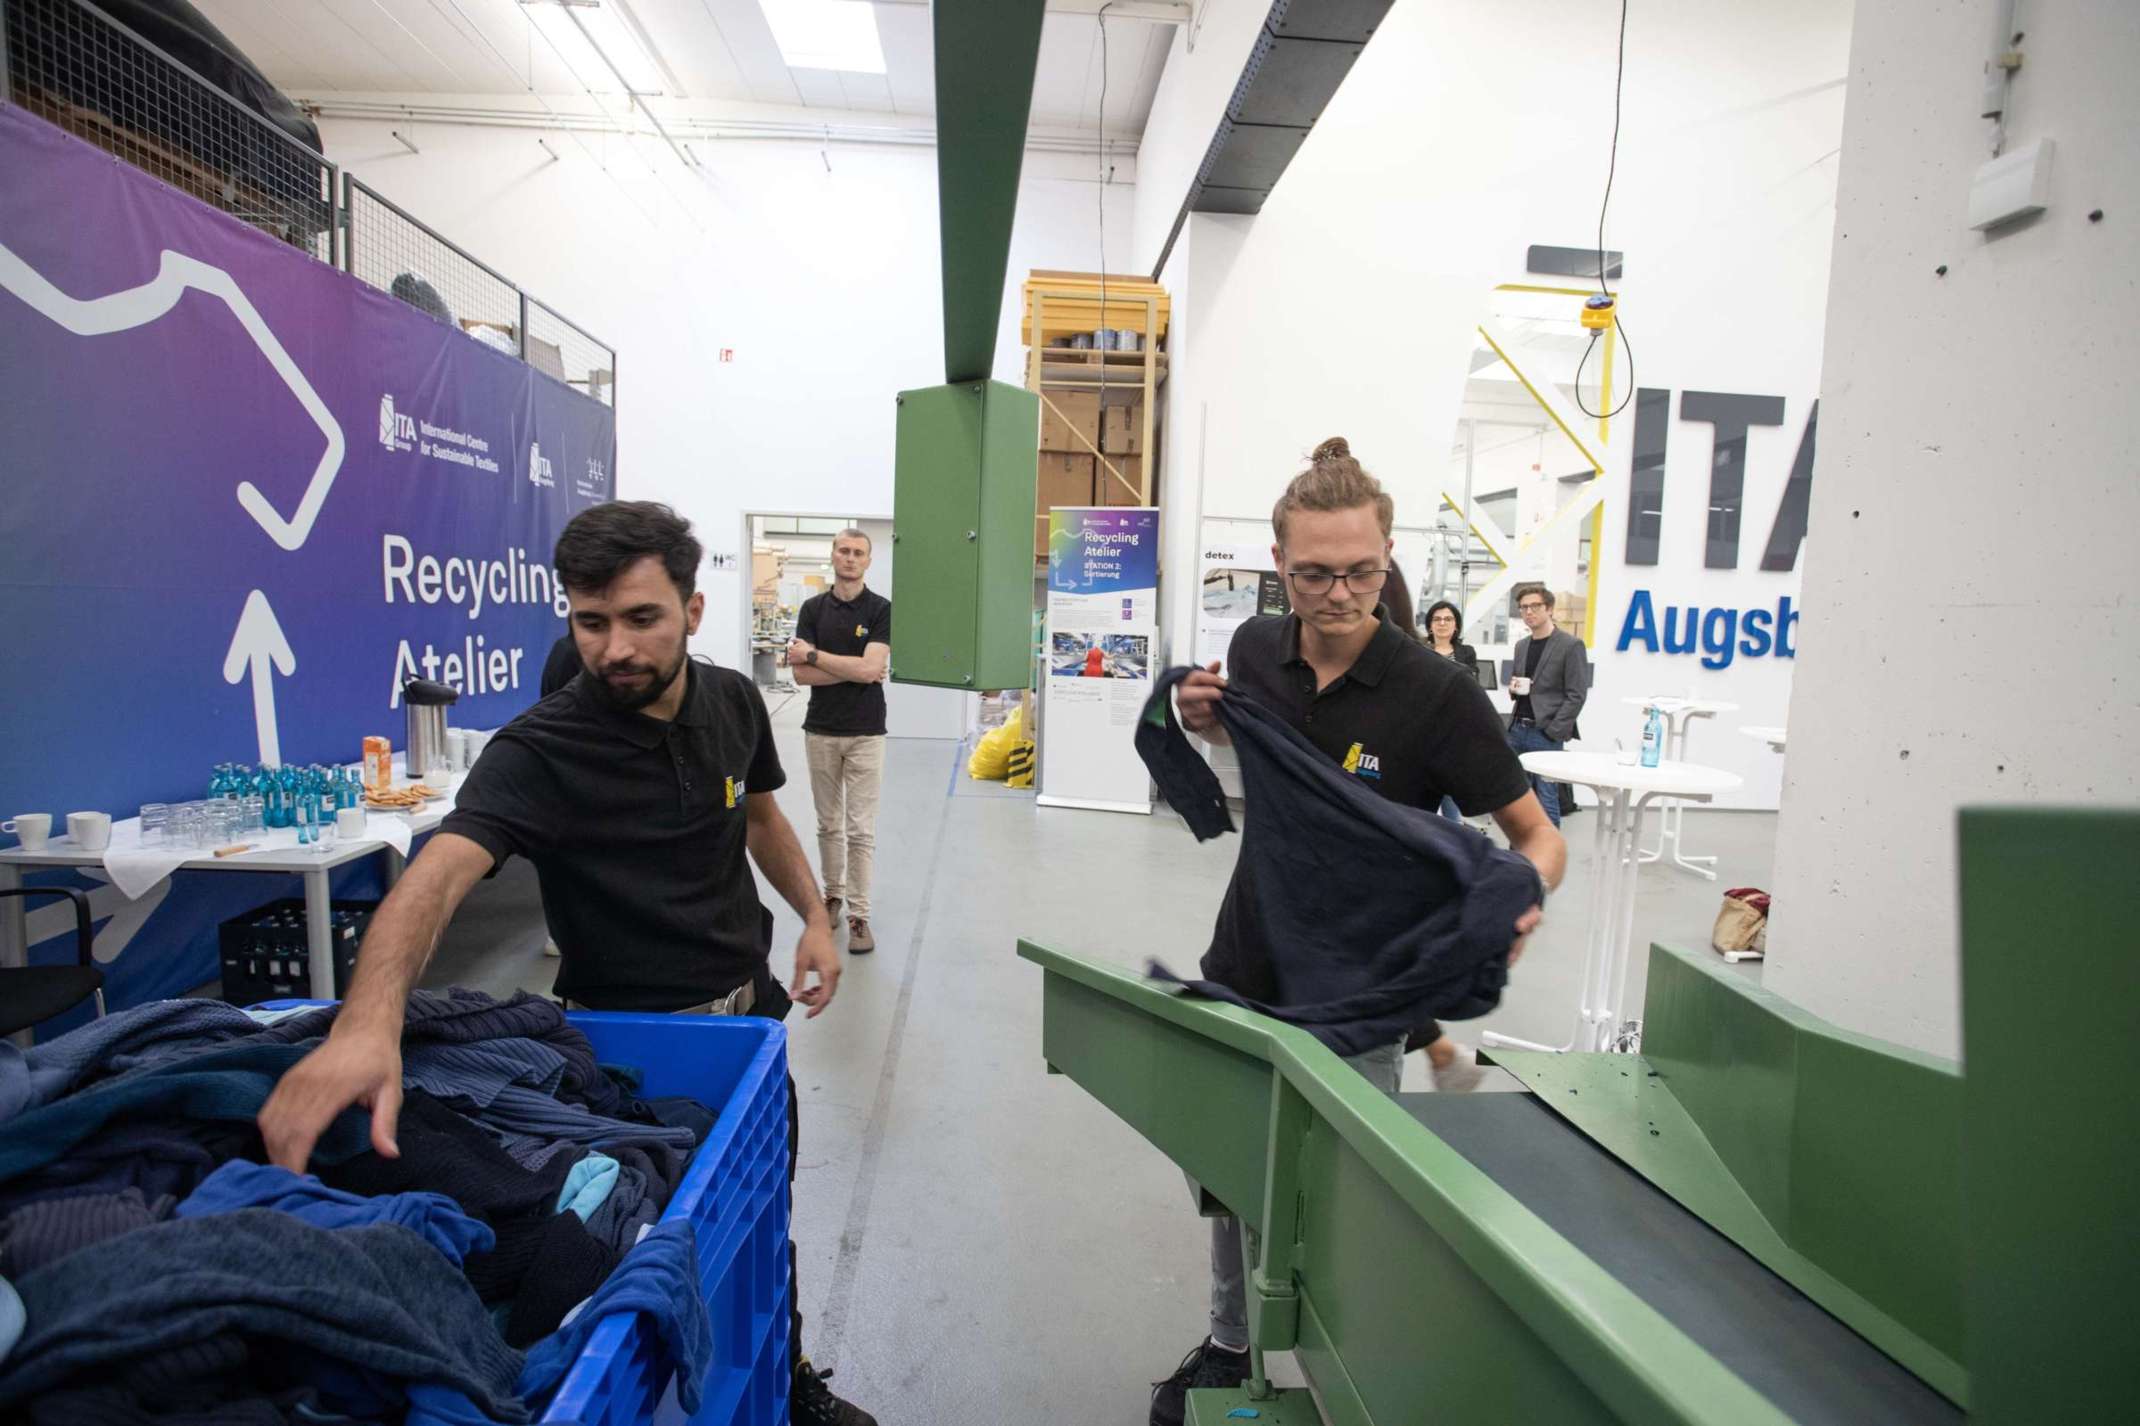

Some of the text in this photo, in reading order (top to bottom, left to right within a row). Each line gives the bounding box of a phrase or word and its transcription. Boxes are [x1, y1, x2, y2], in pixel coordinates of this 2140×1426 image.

[395, 412, 418, 441] ITA
[420, 440, 431, 456] for
[1084, 531, 1139, 546] Recycling
[1084, 546, 1122, 557] Atelier
[1205, 551, 1234, 560] detex
[1084, 562, 1113, 570] STATION
[384, 534, 571, 619] Recycling
[390, 634, 523, 709] Atelier
[1358, 753, 1380, 771] ITA
